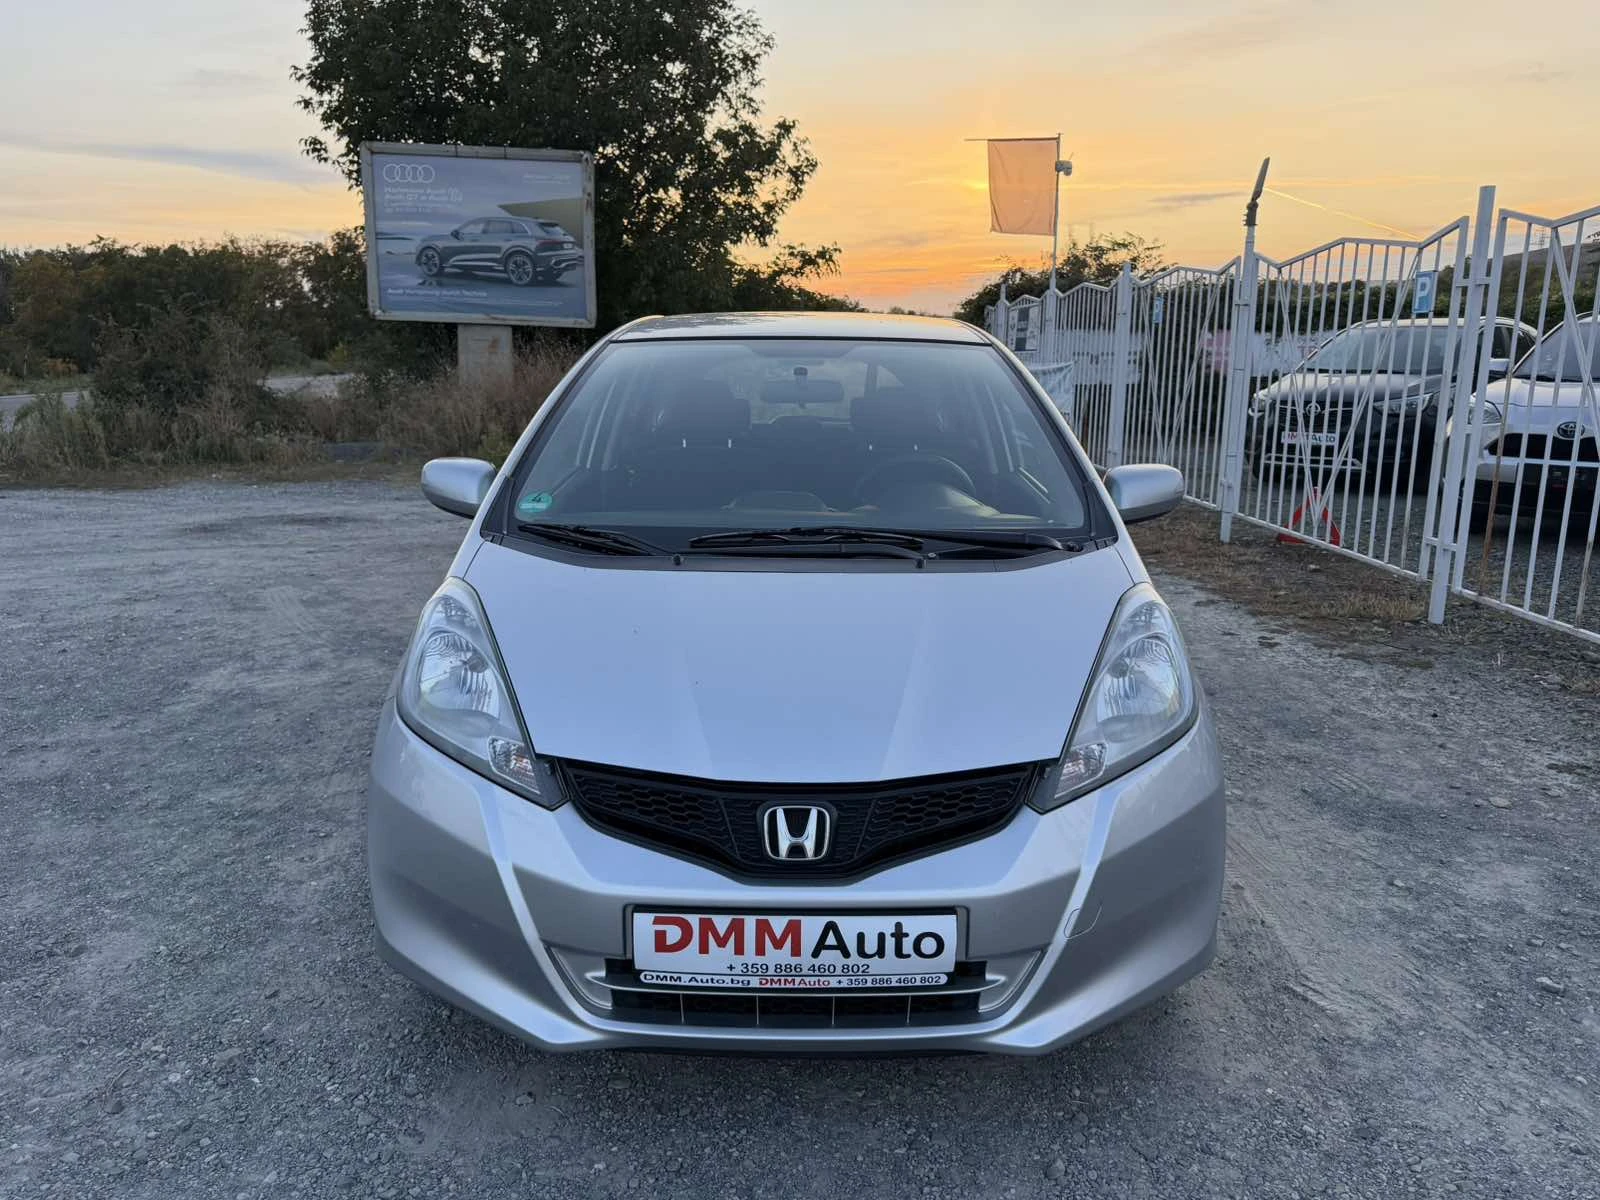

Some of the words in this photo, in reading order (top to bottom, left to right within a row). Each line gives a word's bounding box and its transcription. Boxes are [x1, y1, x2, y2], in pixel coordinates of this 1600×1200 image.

[1415, 277, 1430, 310] P
[774, 963, 803, 974] 886
[807, 963, 837, 974] 460
[841, 963, 870, 974] 802
[643, 973, 751, 987] DMM.Auto.bg
[871, 978, 893, 986] 886
[896, 977, 917, 985] 460
[920, 975, 941, 985] 802
